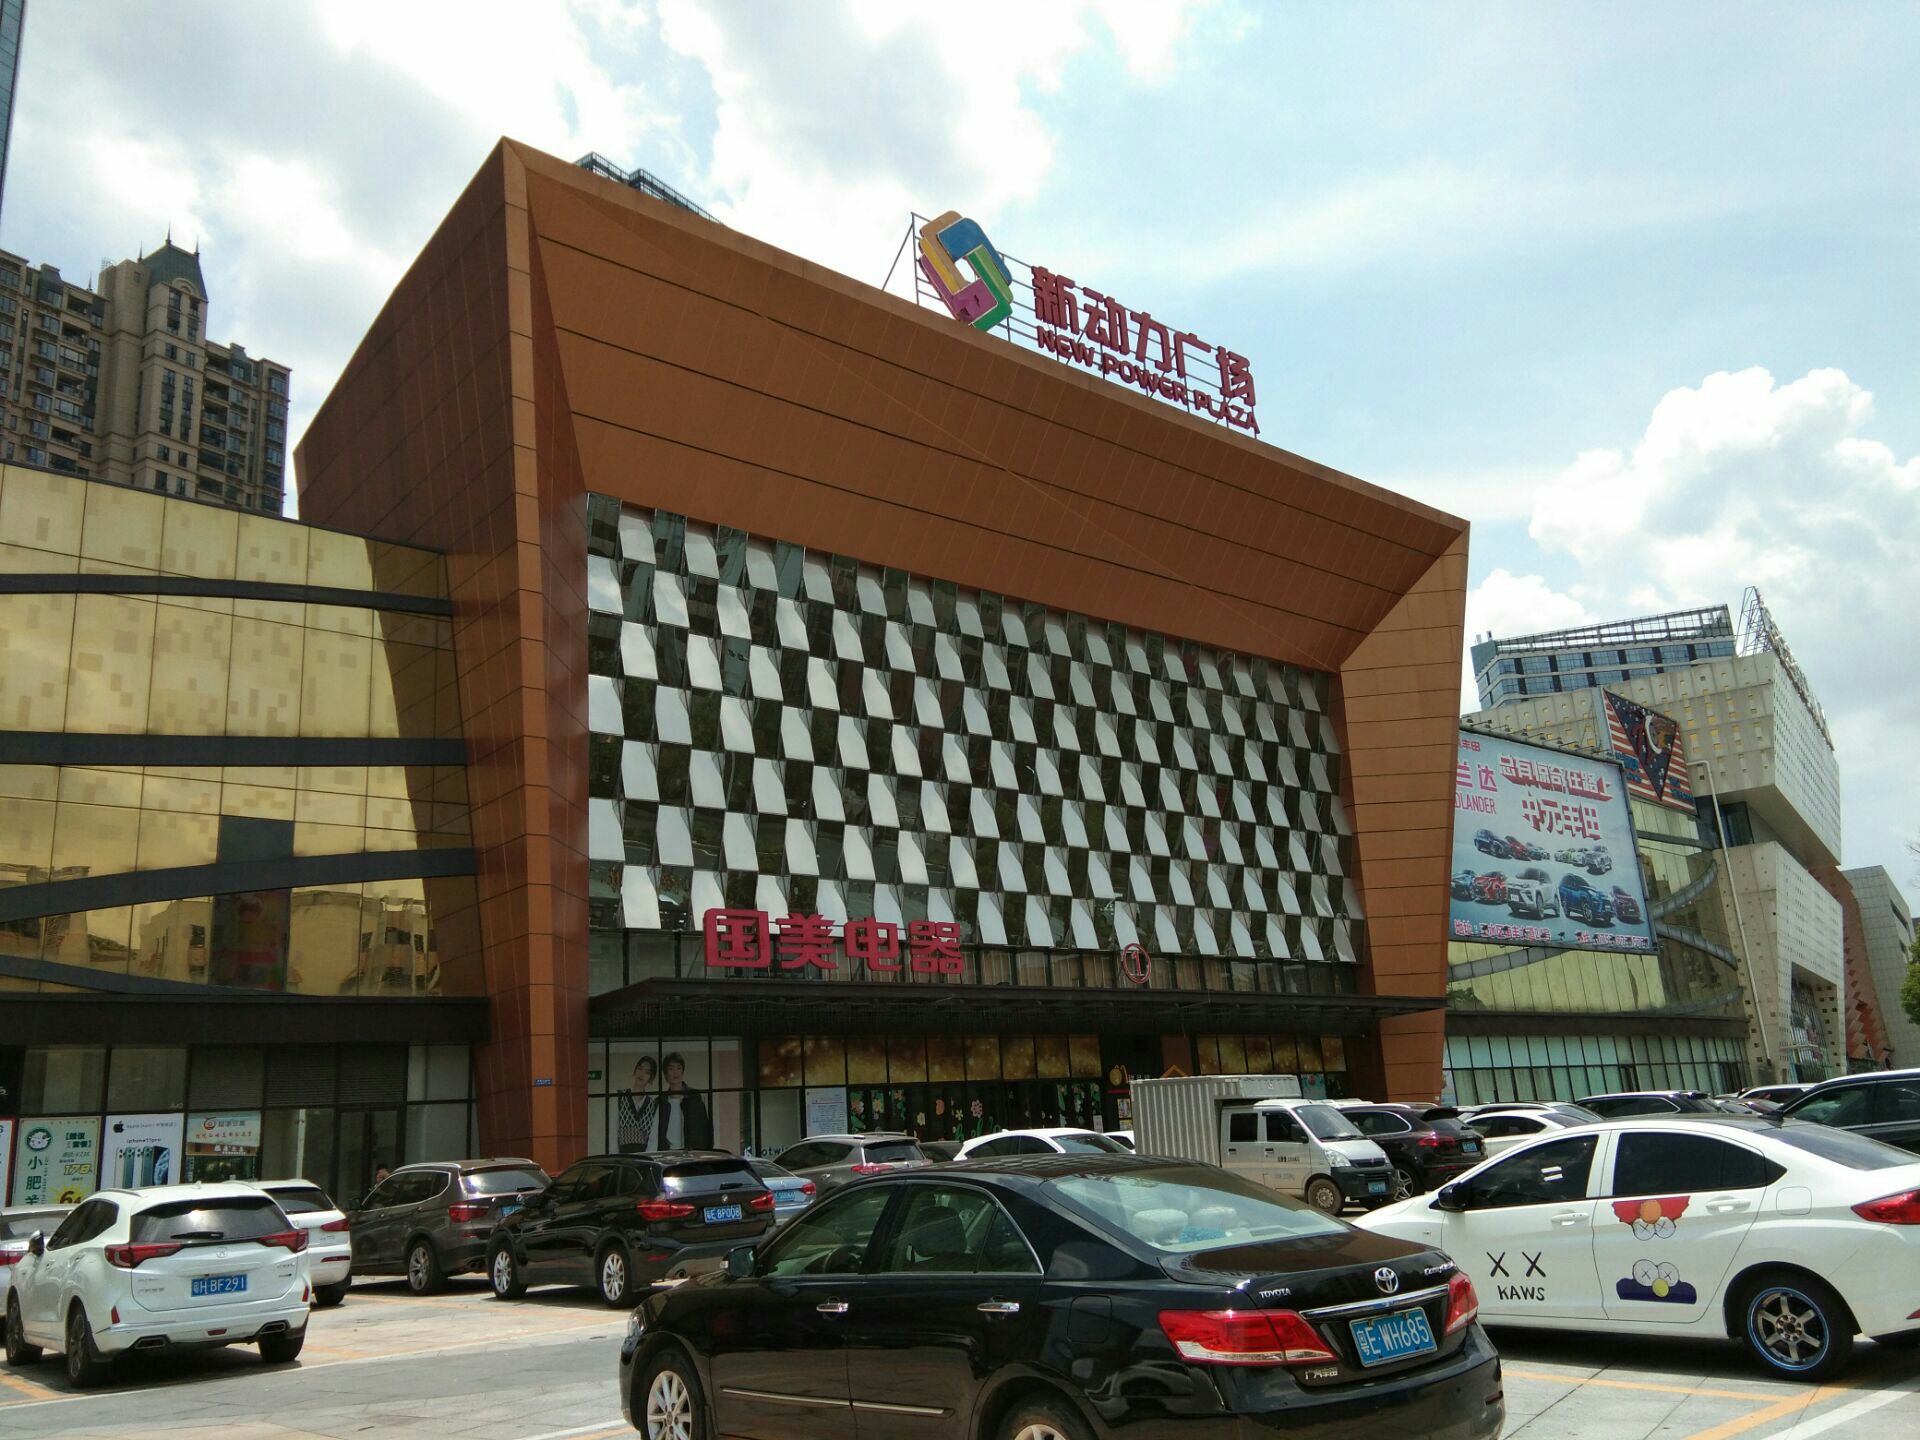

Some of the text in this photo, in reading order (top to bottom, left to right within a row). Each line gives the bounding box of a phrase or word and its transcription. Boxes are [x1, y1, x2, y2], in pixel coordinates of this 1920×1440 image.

[1031, 265, 1256, 406] 新动力广场
[1036, 325, 1261, 434] NEW POWER PLAZA
[1458, 739, 1481, 752] 丰田
[704, 908, 964, 974] 国美电器
[1259, 1287, 1291, 1300] TOYOTA
[1497, 1285, 1545, 1301] KAWS
